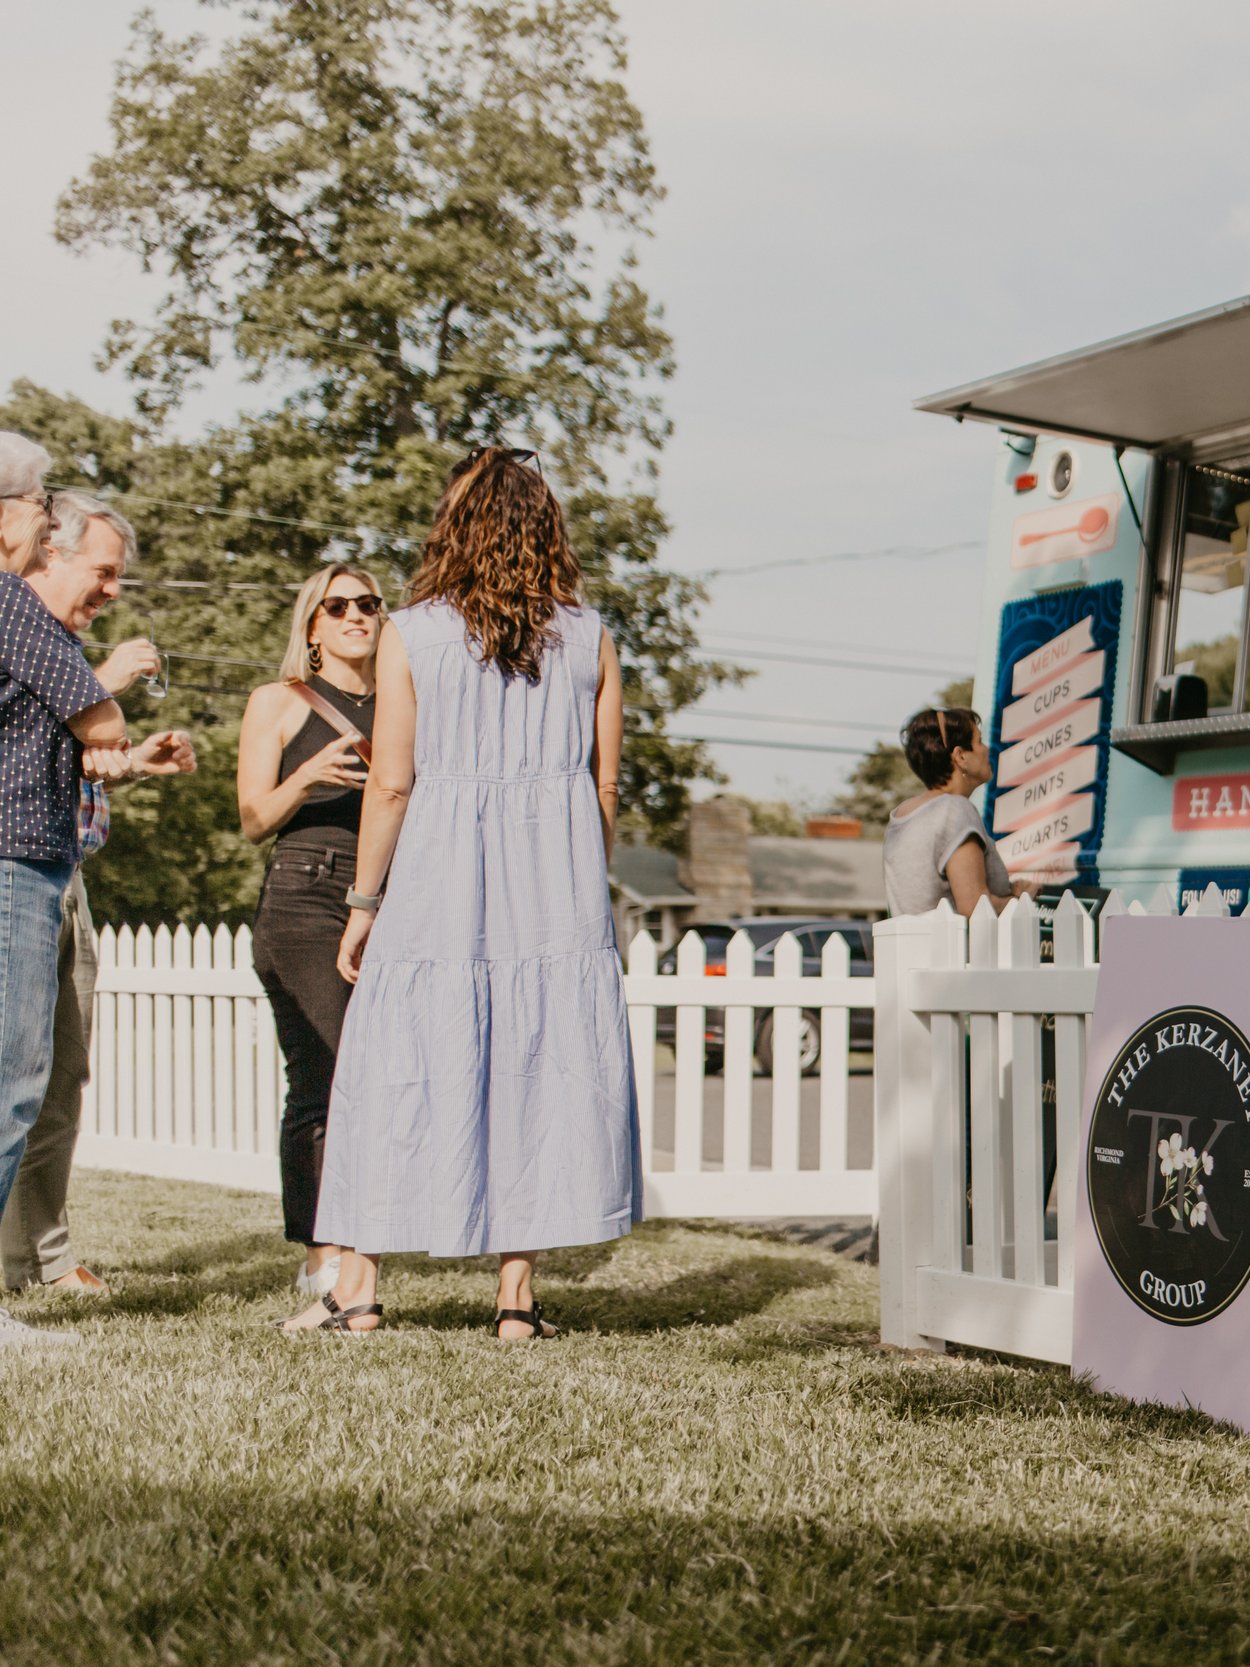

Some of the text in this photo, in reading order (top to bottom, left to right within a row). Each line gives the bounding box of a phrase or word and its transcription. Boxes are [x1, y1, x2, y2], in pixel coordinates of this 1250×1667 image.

[1030, 637, 1071, 675] MENU
[1033, 680, 1070, 713] CUPS
[1024, 724, 1072, 764] CONES
[1023, 771, 1065, 807] PINTS
[1011, 815, 1068, 856] QUARTS
[1108, 1042, 1151, 1107] THE
[1094, 1146, 1125, 1157] RICHMOND
[1096, 1155, 1121, 1165] VIRGINIA
[1139, 1270, 1206, 1308] GROUP
